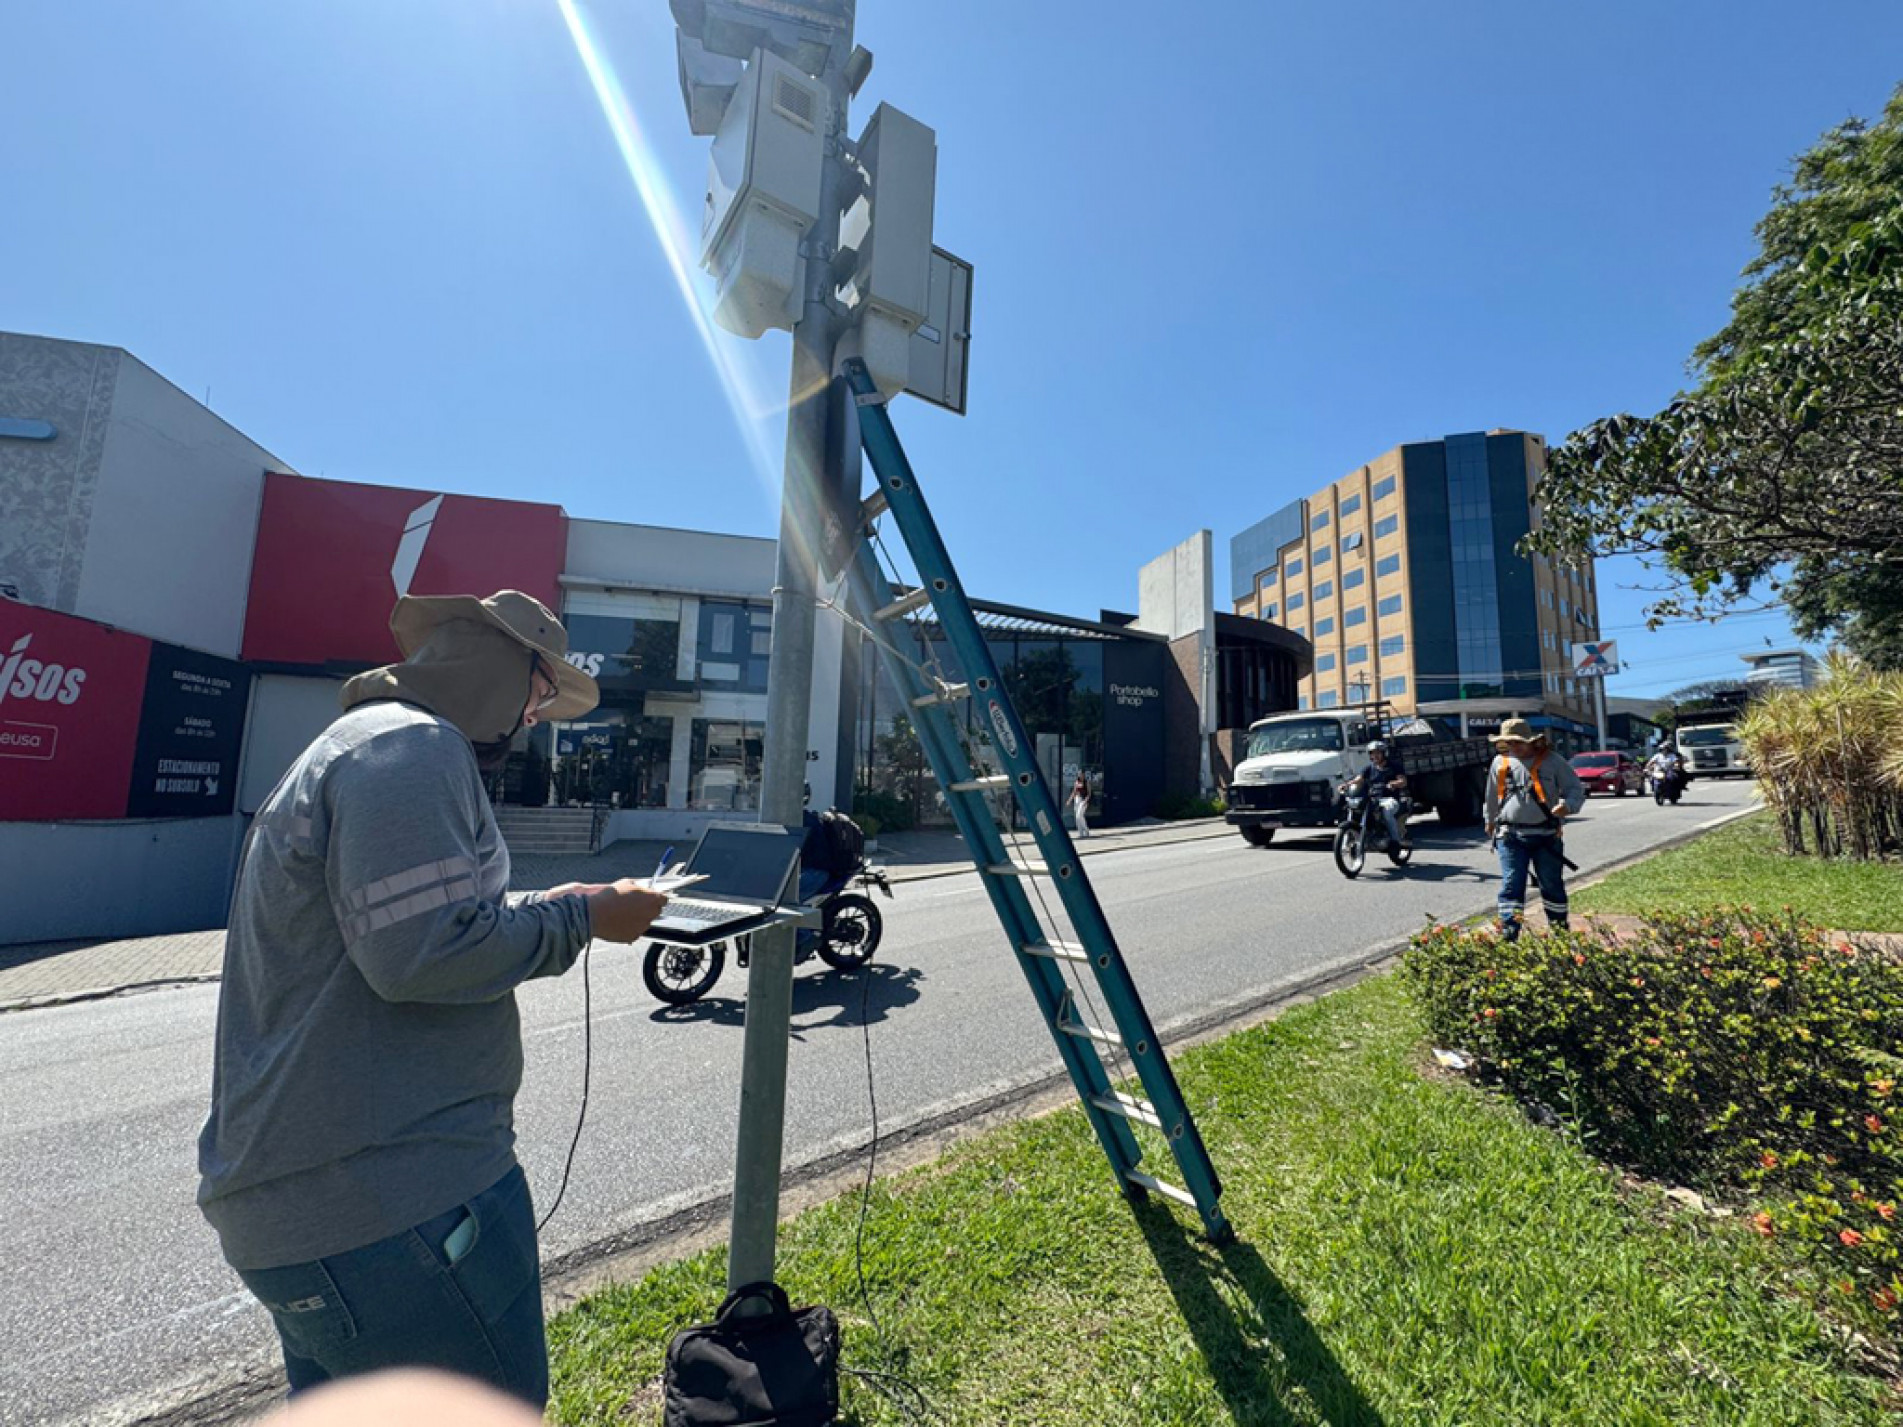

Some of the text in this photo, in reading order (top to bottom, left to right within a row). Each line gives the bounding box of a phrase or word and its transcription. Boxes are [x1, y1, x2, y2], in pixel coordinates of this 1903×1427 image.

[0, 633, 86, 704] ísos
[1576, 666, 1616, 677] CAIXA
[1109, 683, 1158, 697] Portobello
[1117, 694, 1143, 707] shop
[0, 732, 41, 747] eusa
[157, 759, 220, 775] ESTACIONAMENTO
